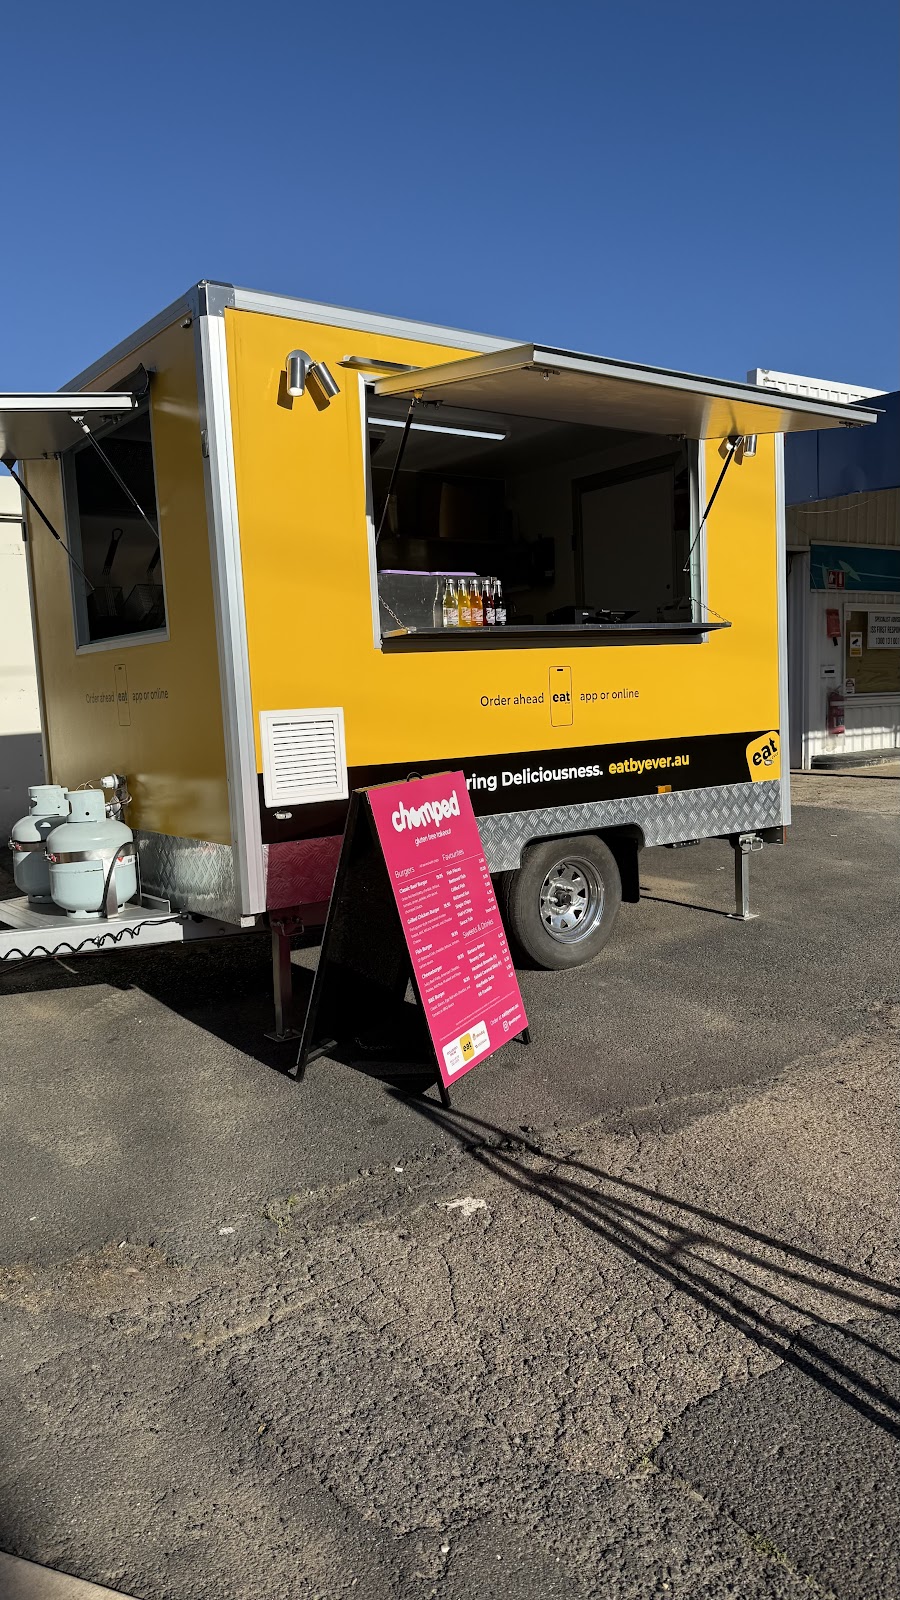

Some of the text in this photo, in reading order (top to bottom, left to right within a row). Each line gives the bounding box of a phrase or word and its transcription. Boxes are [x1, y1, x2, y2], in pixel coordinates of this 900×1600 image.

[86, 692, 100, 704] Order
[100, 691, 114, 703] ahead
[132, 692, 142, 704] app
[143, 692, 150, 700] or
[150, 688, 168, 700] online
[480, 688, 640, 707] Order ahead eat app or online
[753, 738, 778, 766] eat
[502, 764, 604, 788] Deliciousness.
[608, 753, 690, 774] eatbyever.au
[392, 790, 460, 832] chomped
[414, 836, 428, 847] gluten
[441, 849, 464, 860] Favourites
[394, 866, 415, 878] Burgers
[462, 927, 478, 938] Sweets
[480, 919, 494, 930] Drinks
